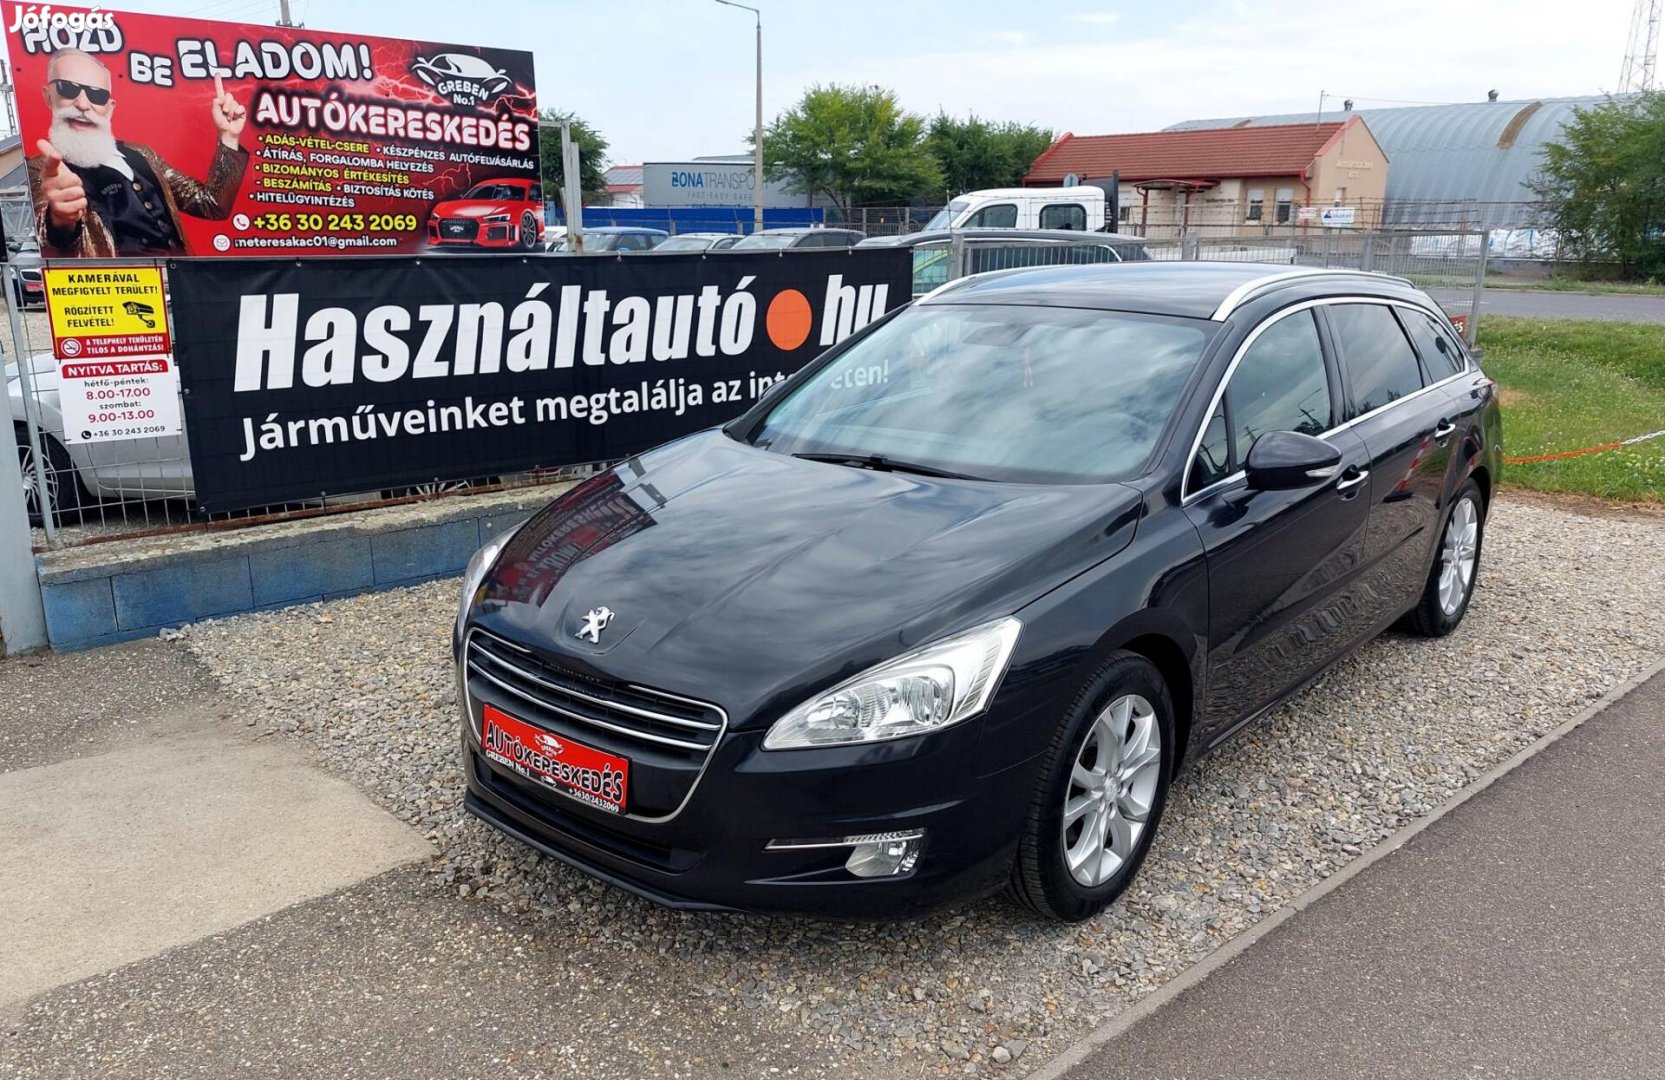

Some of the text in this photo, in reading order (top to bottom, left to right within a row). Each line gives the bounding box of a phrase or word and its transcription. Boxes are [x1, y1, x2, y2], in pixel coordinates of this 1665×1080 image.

[130, 52, 173, 87] BE
[177, 40, 373, 80] ELADOM!
[437, 80, 489, 101] GREBEN
[453, 93, 475, 105] No.1
[256, 92, 531, 151] AUTÓKERESKEDÉS
[265, 134, 535, 170] ADÁS-VÉTEL-CSERE KÉSZPÉNZES AUTÓFELVÁSÁRLÁS
[262, 147, 434, 173] ÁTÍRÁS, FORGALOMBA HELYEZÉS
[262, 163, 409, 184] BIZOMÁNYOS ÉRTÉKESÍTÉS
[263, 178, 435, 200] BESZÁMÍTÁS BIZTOSÍTÁS KÖTÉS
[256, 192, 355, 208] HITELÜGYINTÉZÉS
[254, 214, 417, 231] +36 30 243 2069
[68, 272, 140, 284] KAMERÁVAL
[52, 287, 111, 296] MEGFIGYELT
[115, 285, 158, 295] TERÜLET!
[64, 305, 114, 316] RÖGZÍTETT
[67, 318, 114, 328] FELVÉTEL!
[92, 337, 127, 346] TELEPHELY
[128, 335, 163, 345] TERÜLETÉN
[87, 346, 109, 354] TILOS
[118, 343, 164, 353] DOHÁNYZÁS!
[68, 359, 163, 377] NYITVA TARTÁS:
[84, 377, 149, 388] hétfő-péntek:
[86, 387, 151, 400] 8.00-17.00
[99, 401, 142, 410] szombat:
[88, 410, 155, 423] 9.00-13.00
[240, 396, 525, 462] Járműveinket
[536, 378, 703, 426] megtalálja
[712, 379, 742, 404] az
[125, 427, 142, 435] 243
[143, 425, 166, 434] 2069
[485, 719, 624, 804] AUTÓKERESKEDÉS
